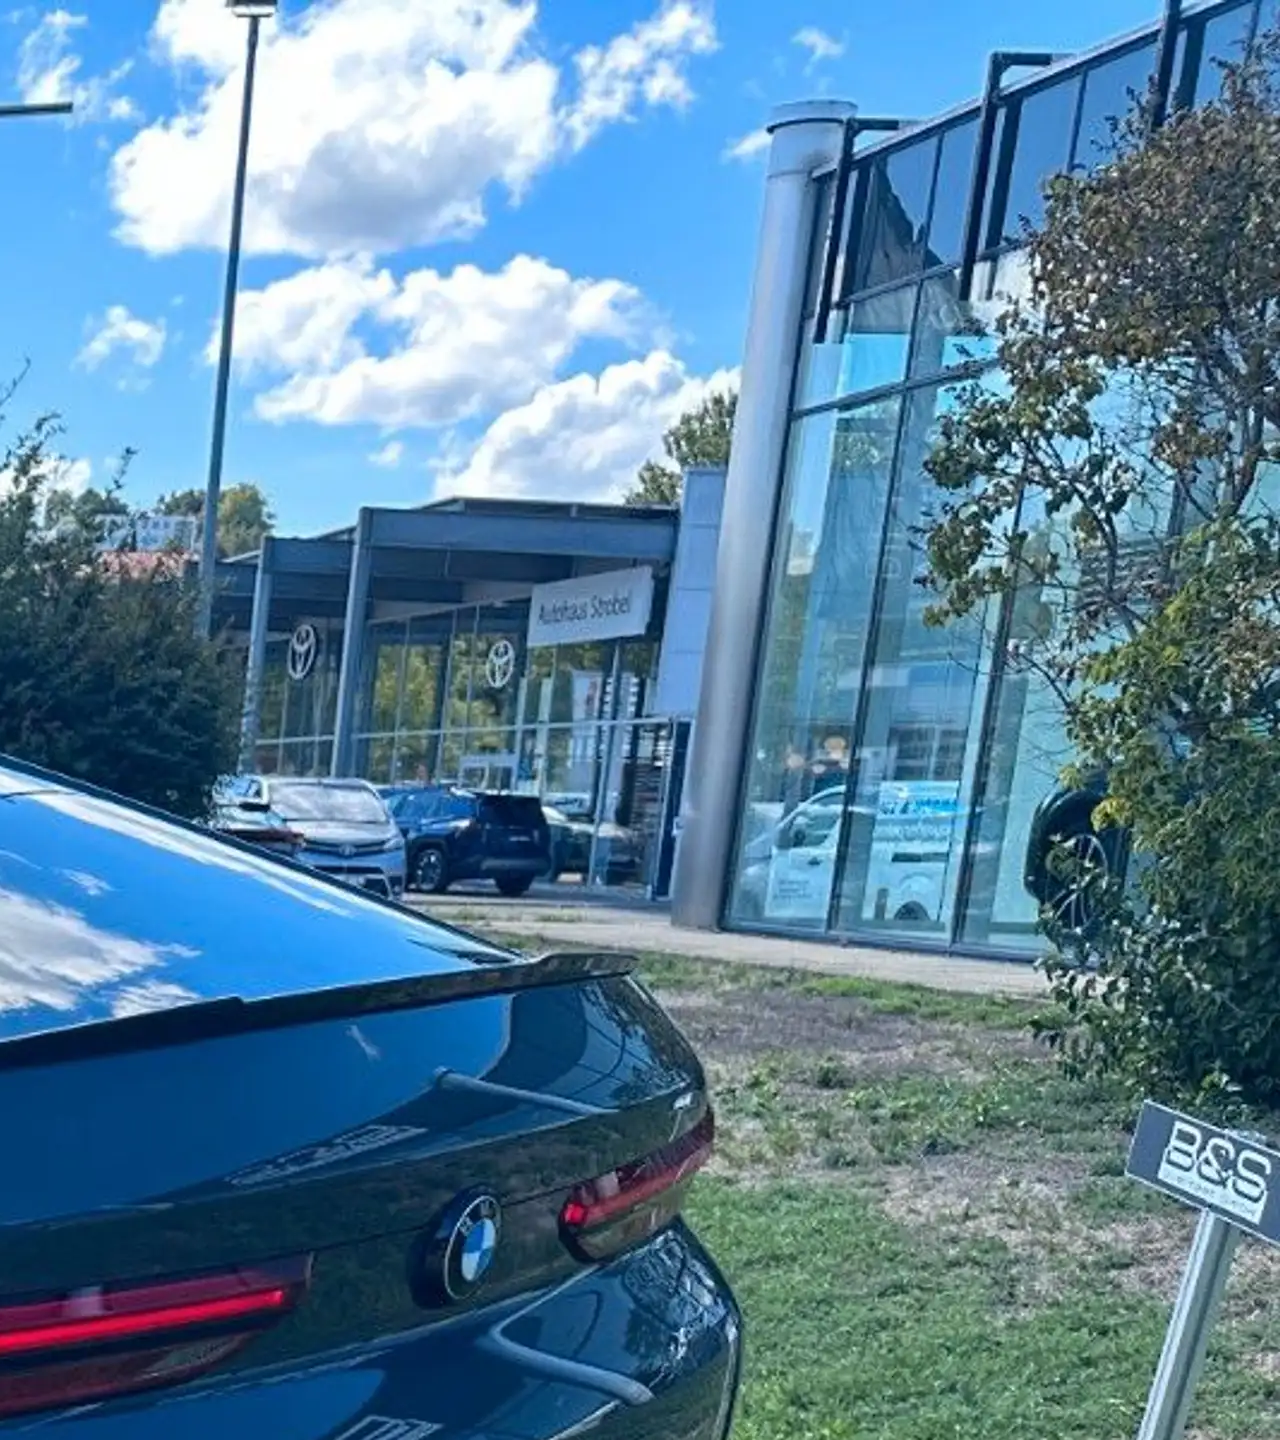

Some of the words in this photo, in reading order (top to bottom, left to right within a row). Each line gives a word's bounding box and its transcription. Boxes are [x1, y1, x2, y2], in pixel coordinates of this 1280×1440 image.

[538, 599, 587, 624] Autohaus
[590, 588, 631, 618] Strobel
[1166, 1120, 1272, 1204] B&S
